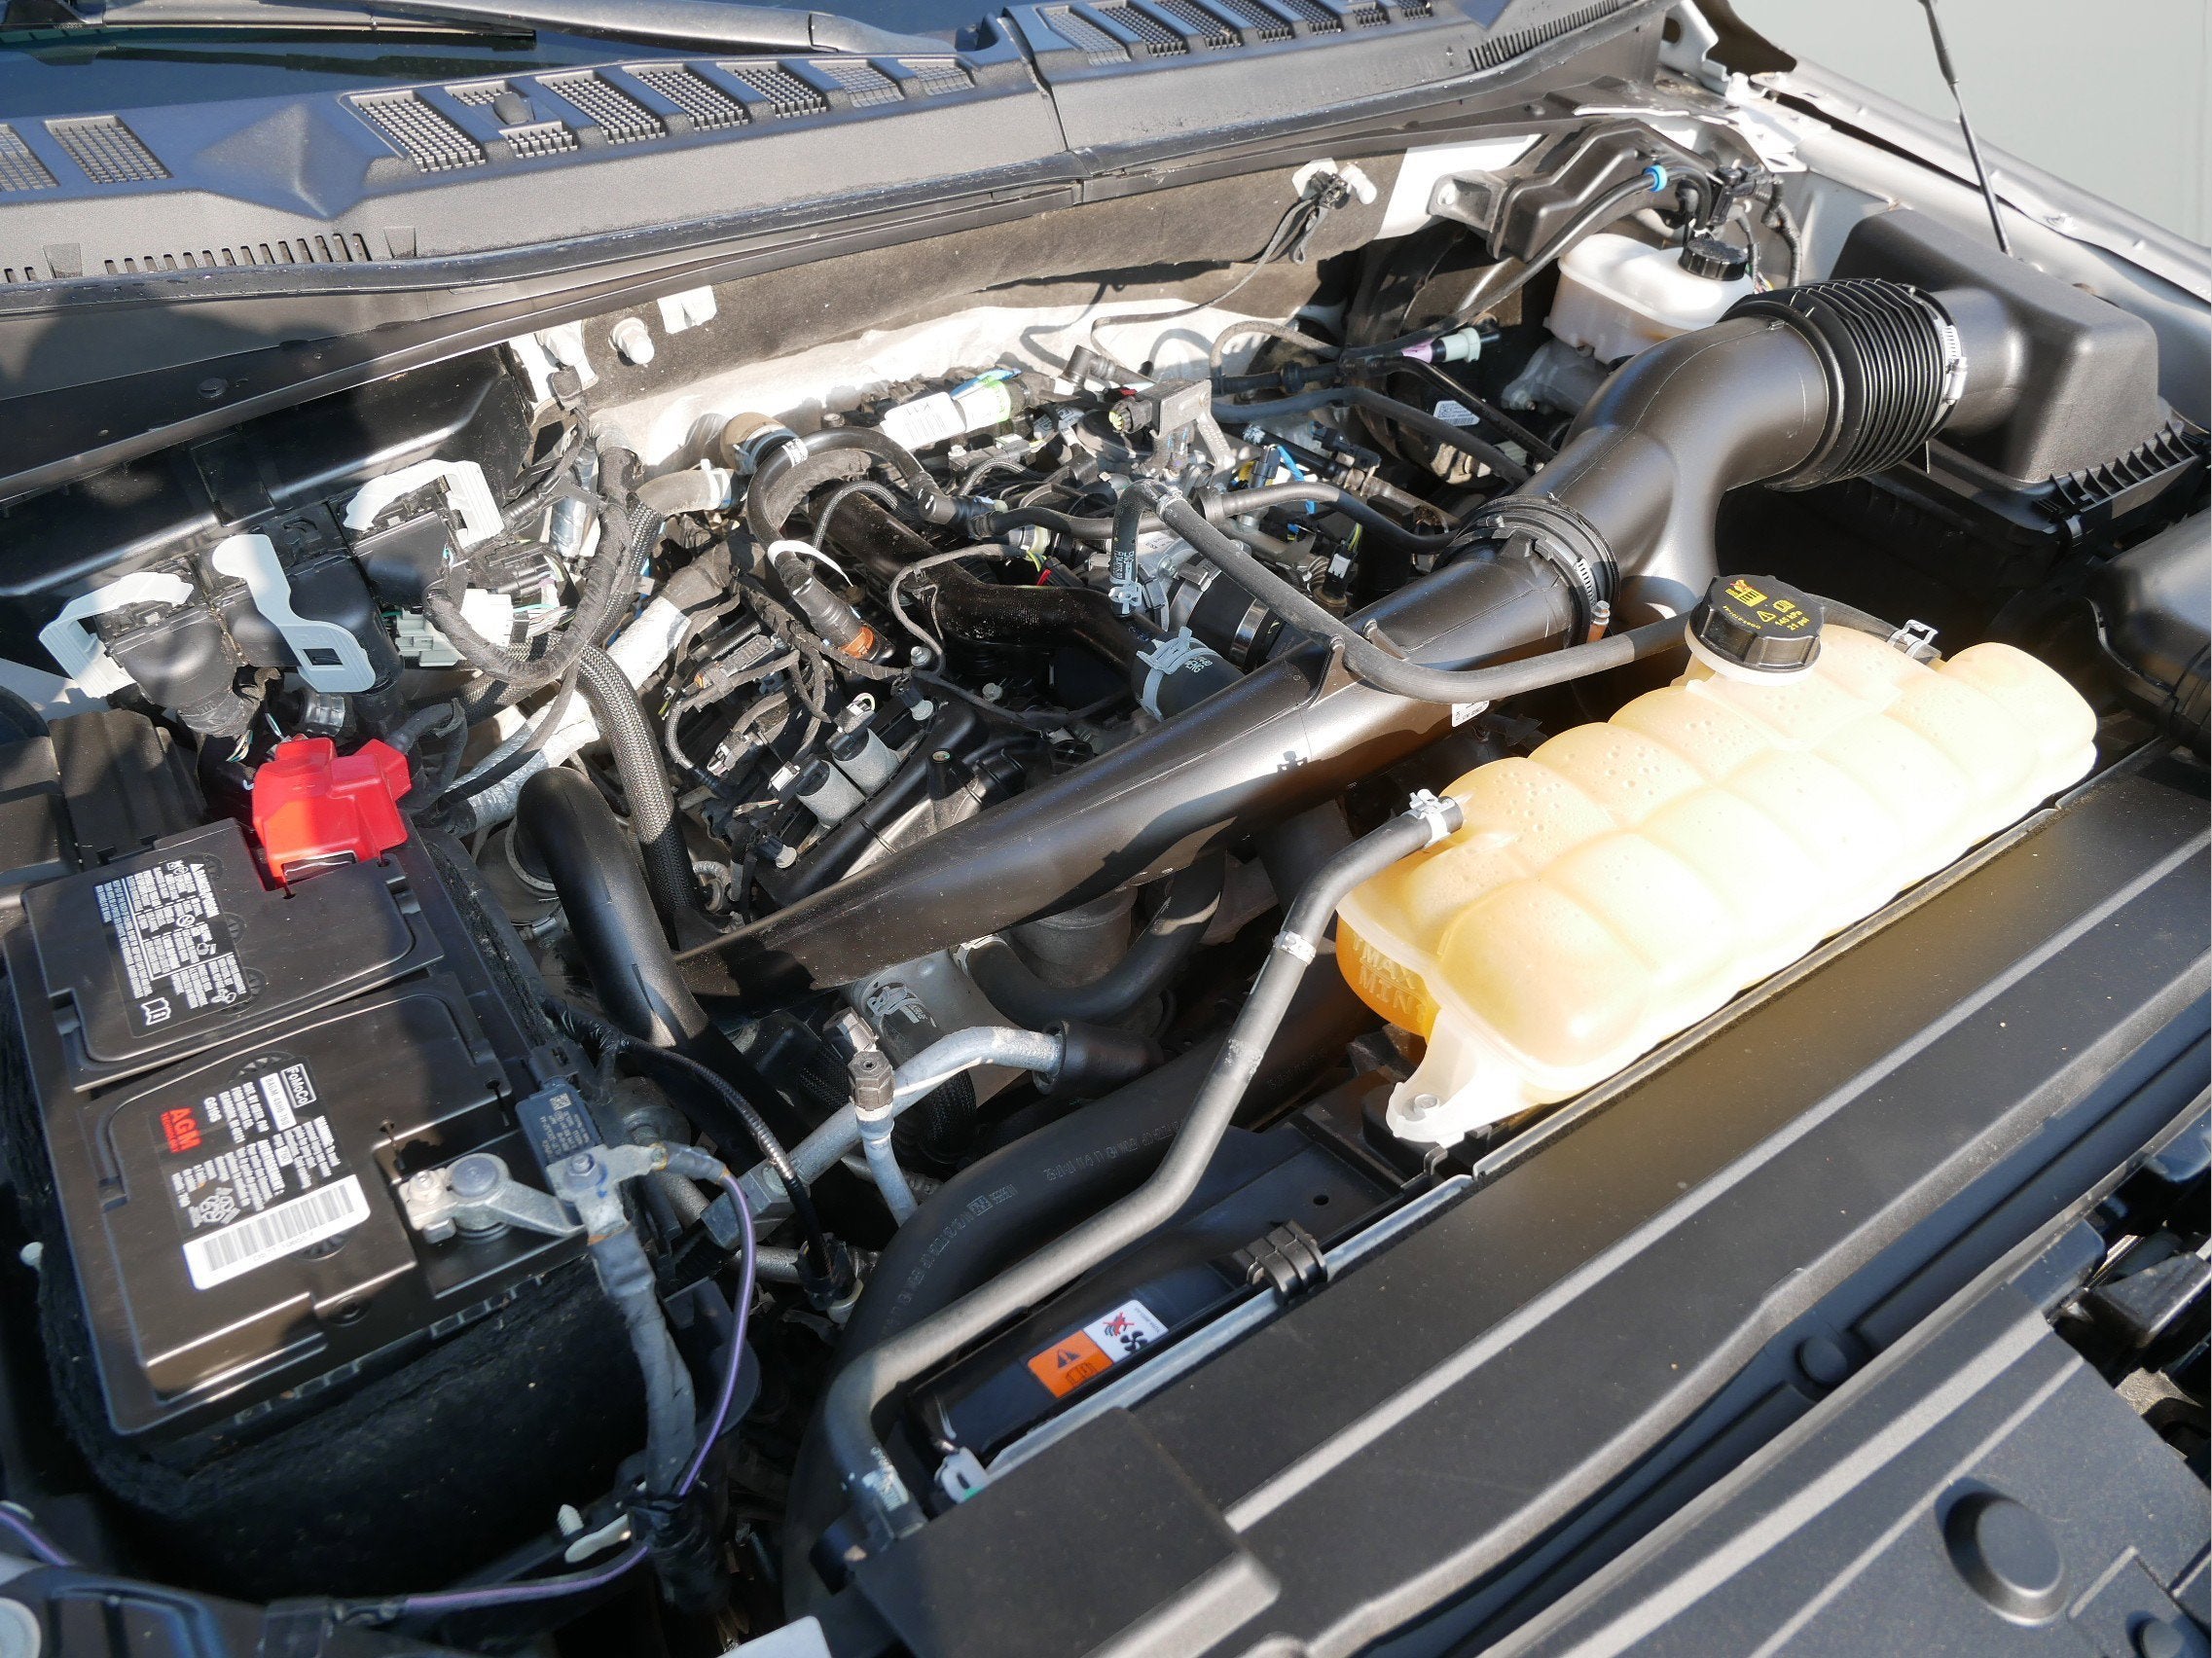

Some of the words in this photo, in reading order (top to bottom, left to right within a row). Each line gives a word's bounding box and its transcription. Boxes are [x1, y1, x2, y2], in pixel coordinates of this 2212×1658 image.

[1775, 616, 1790, 627] 145
[1787, 610, 1803, 620] kPa
[1796, 617, 1810, 627] psi
[1361, 940, 1416, 989] MAX
[1359, 965, 1413, 1014] MIN
[287, 1065, 309, 1105] FoMoCo
[169, 1104, 202, 1151] AGM
